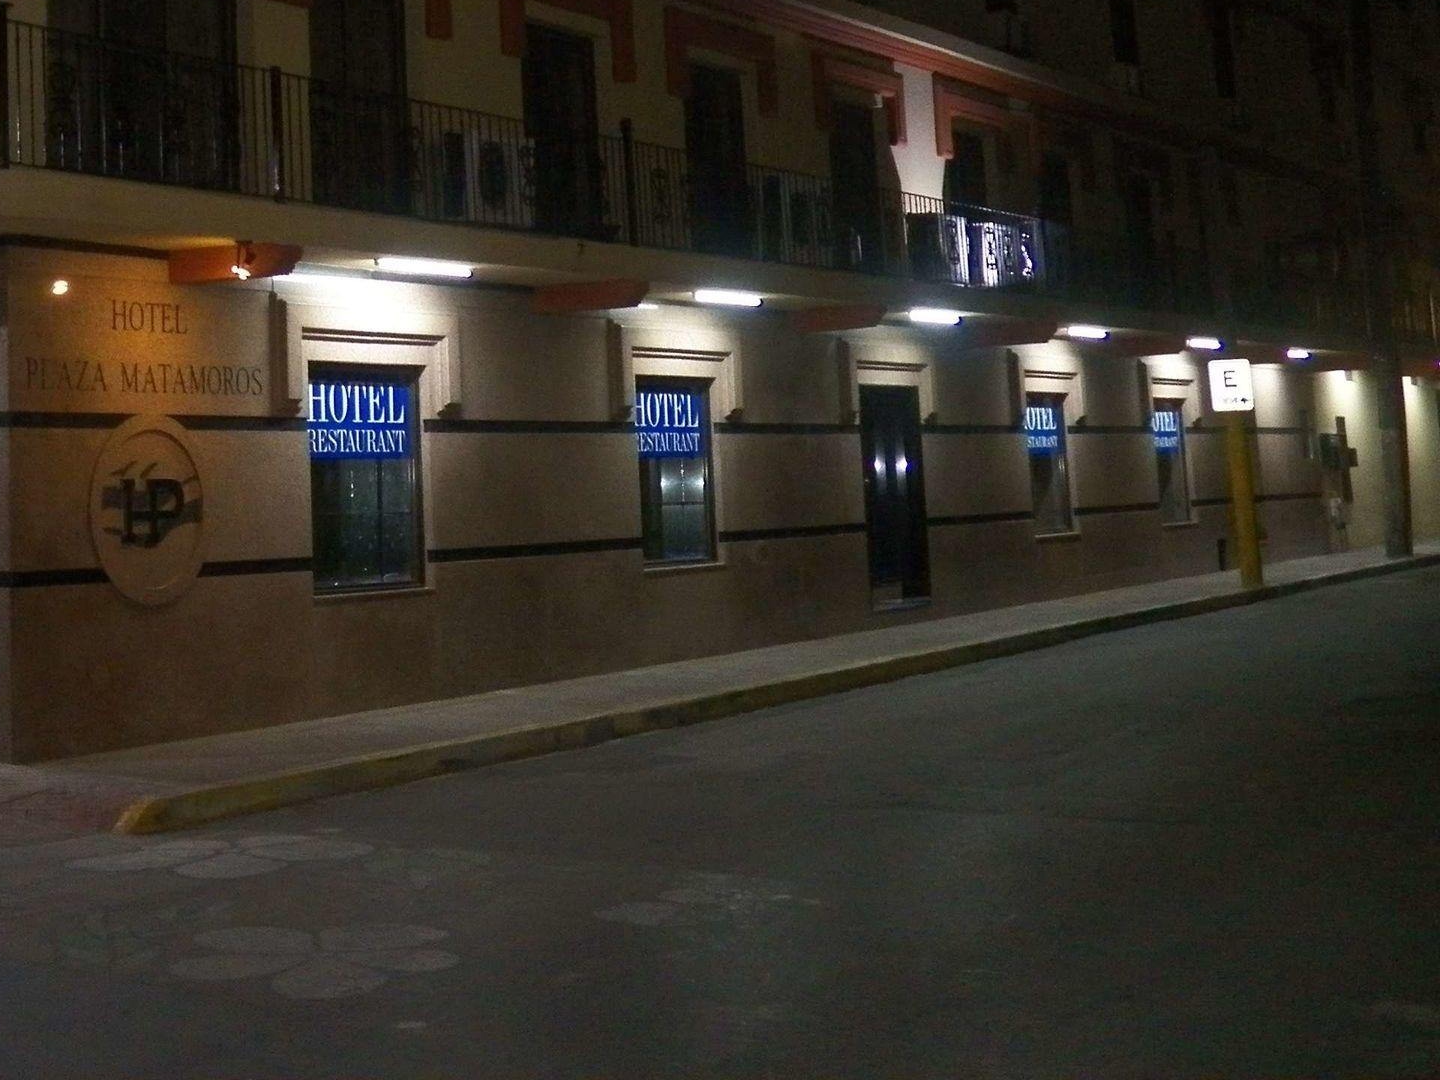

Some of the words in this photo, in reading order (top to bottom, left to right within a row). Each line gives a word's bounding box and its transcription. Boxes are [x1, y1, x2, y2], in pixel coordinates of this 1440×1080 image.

[111, 299, 188, 335] HOTEL
[25, 356, 108, 393] PLAZA
[120, 361, 264, 396] MATAMOROS
[1224, 370, 1238, 387] E
[307, 383, 405, 425] HOTEL
[635, 392, 699, 428] HOTEL
[1024, 406, 1058, 430] OTEL
[1151, 411, 1177, 432] OTEL
[307, 428, 407, 454] RESTAURANT
